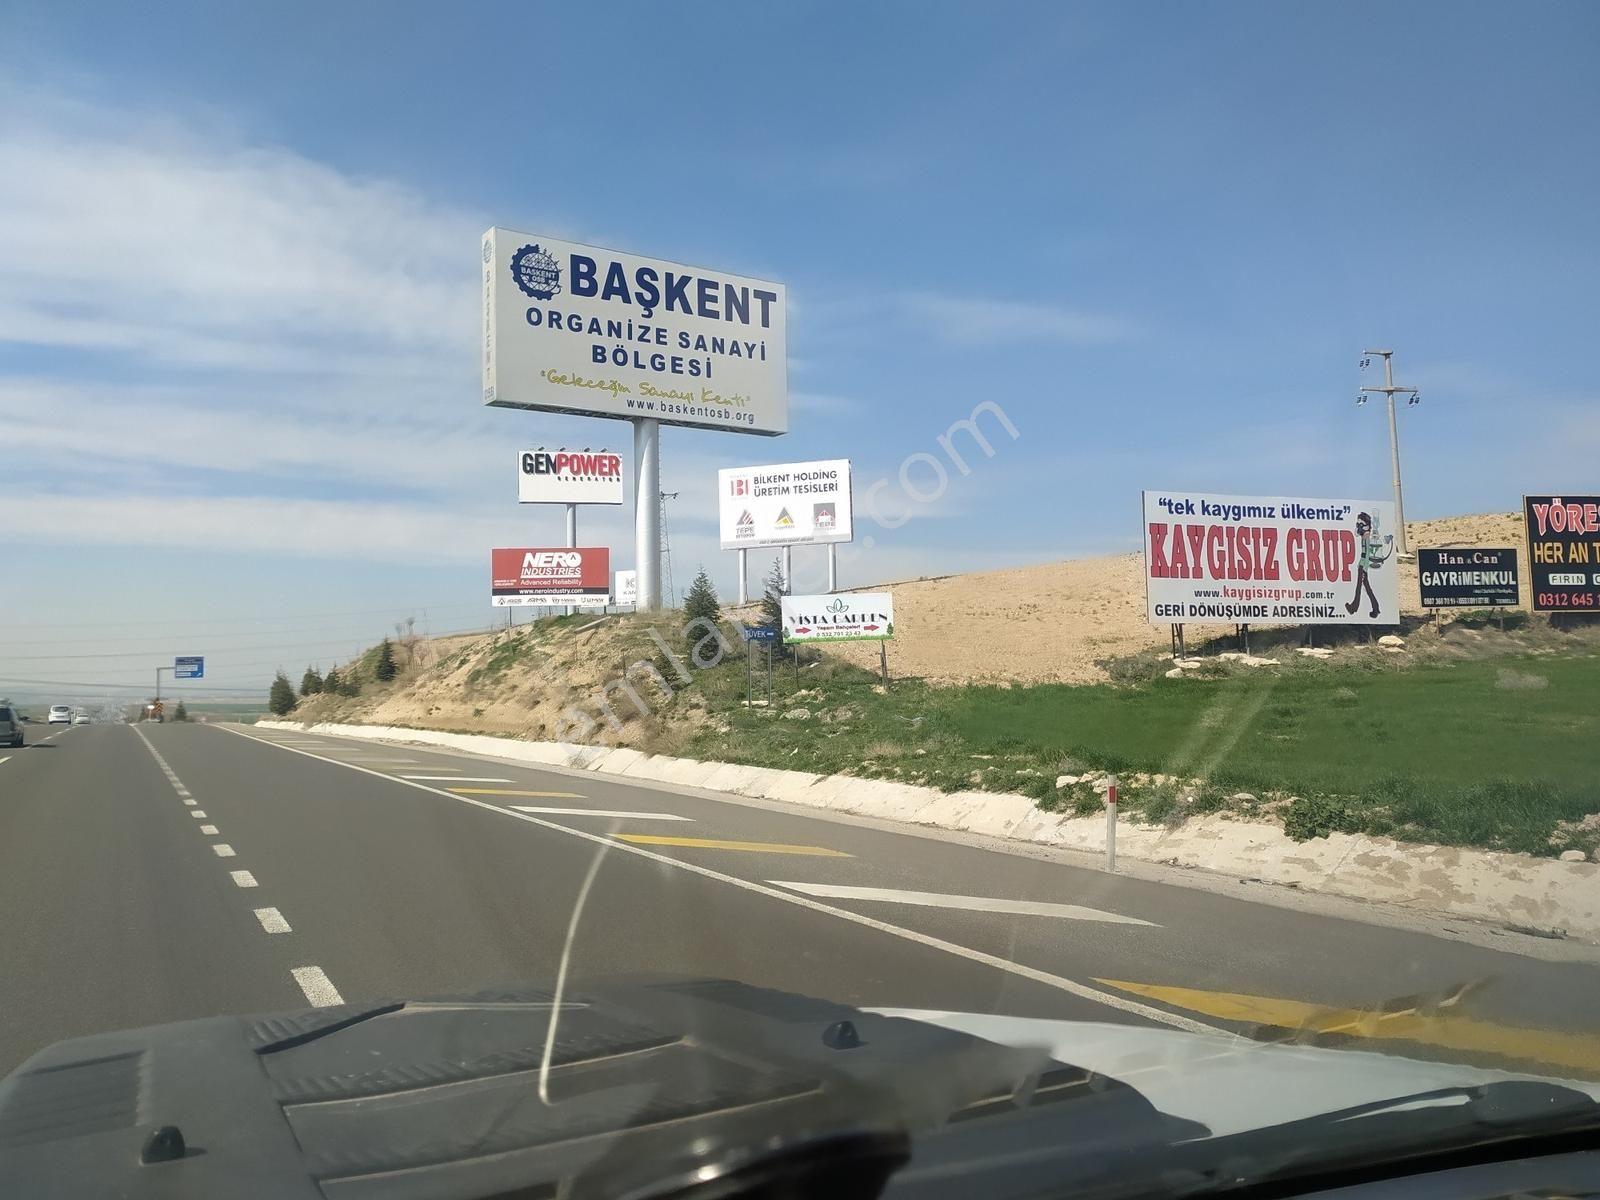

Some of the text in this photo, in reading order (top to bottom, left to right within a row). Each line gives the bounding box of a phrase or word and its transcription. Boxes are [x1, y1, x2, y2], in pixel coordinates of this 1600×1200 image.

[569, 253, 777, 329] BAŞKENT
[526, 307, 766, 361] ORGANİZE SANAYİ
[592, 344, 712, 379] BÖLGESİ
[627, 399, 755, 425] www.baskentosb.org
[522, 453, 620, 476] GENPOWER
[753, 469, 837, 485] BİLKENT HOLDİNG
[753, 480, 838, 497] ÜRETİM TESİSLERİ
[1532, 498, 1600, 537] YÖRE
[522, 552, 582, 568] NERO
[1149, 522, 1356, 583] KAYGISIZ GRUP
[1438, 553, 1464, 565] Han
[1473, 552, 1498, 564] Can
[1533, 542, 1565, 564] HER
[1568, 542, 1589, 564] AN
[521, 567, 582, 576] INDUSTRIES
[1551, 575, 1584, 584] FIRIN
[520, 578, 551, 586] Advanced
[552, 578, 583, 587] Reliability
[519, 588, 584, 596] www.neroindustry.com
[1194, 585, 1335, 602] www.kaygisizgrup.com.tr
[1539, 593, 1568, 606] 0312
[1571, 593, 1593, 606] 645
[832, 613, 888, 624] GARDEN
[1154, 601, 1346, 620] GERİ DÖNÜŞÜMDE ADRESİNİZ...
